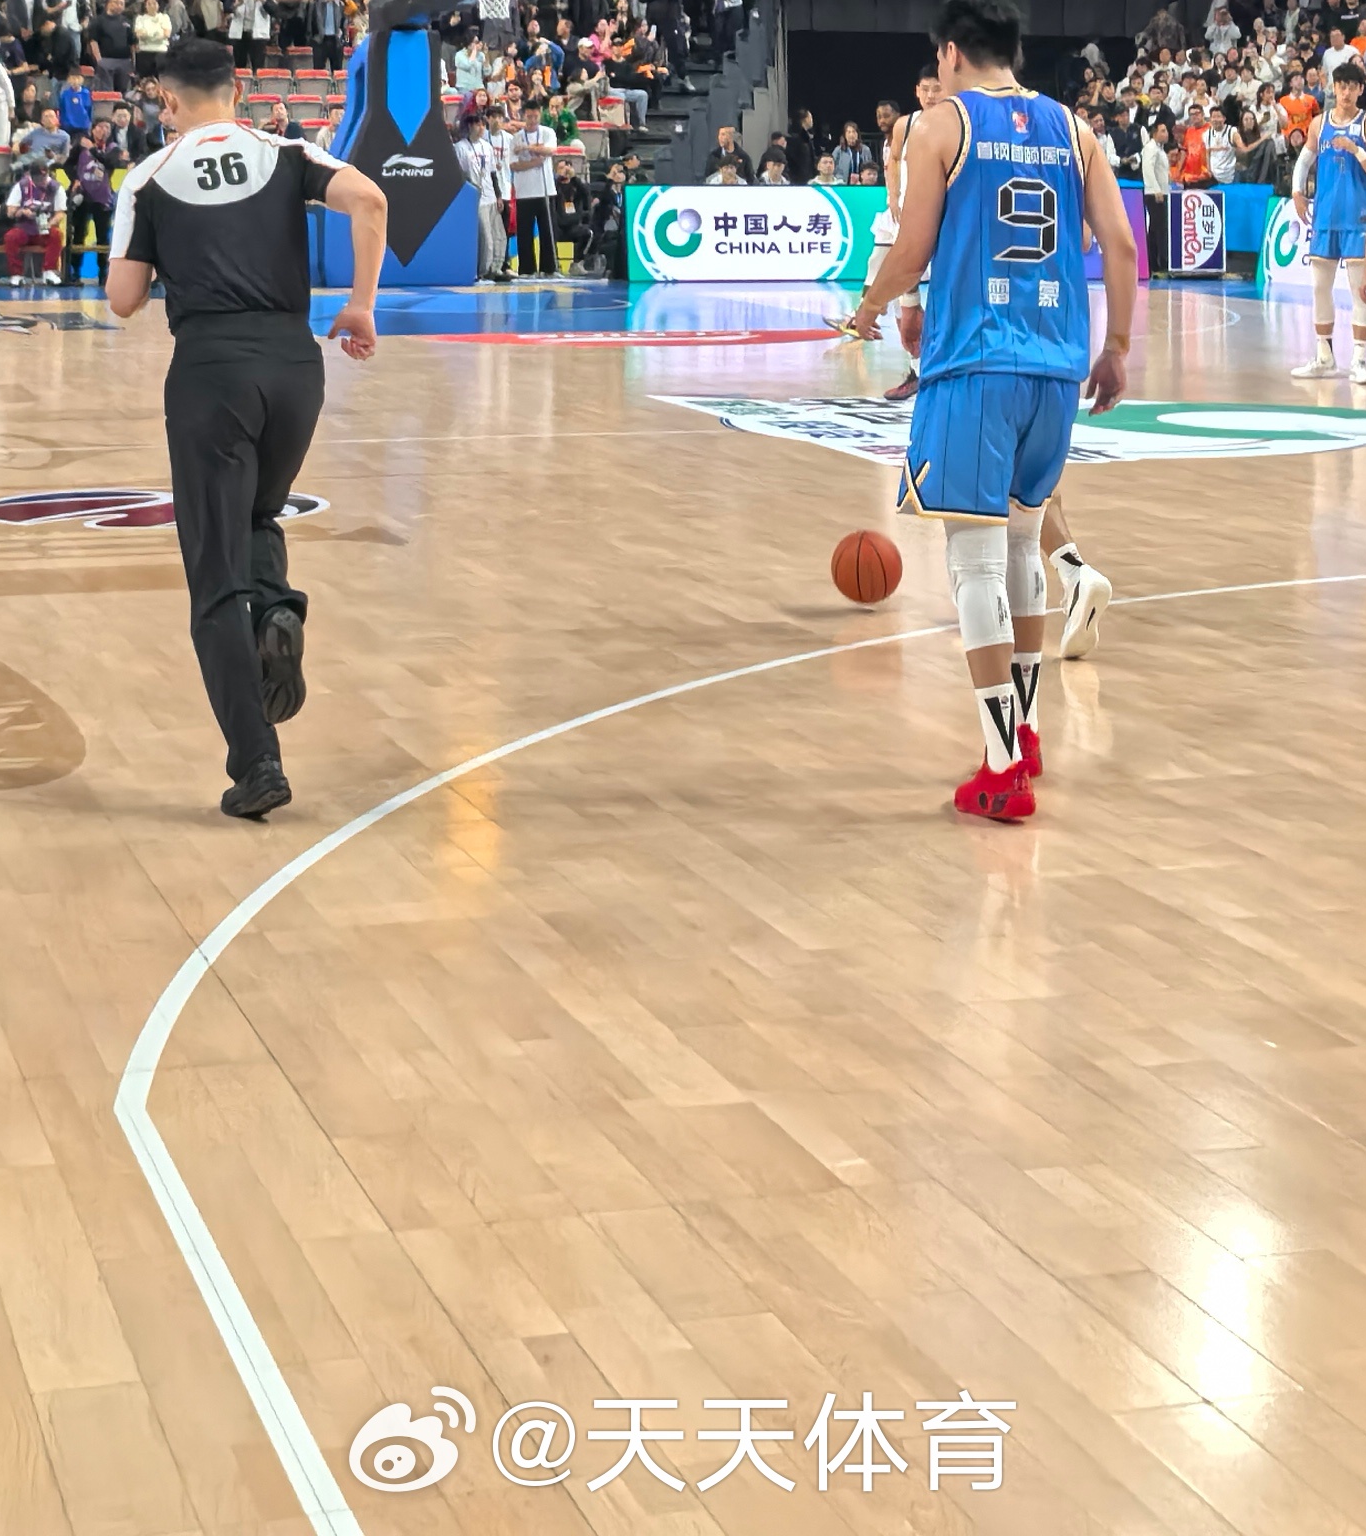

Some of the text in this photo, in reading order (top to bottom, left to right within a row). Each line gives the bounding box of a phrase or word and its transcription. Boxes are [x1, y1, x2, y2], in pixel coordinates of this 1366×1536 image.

[193, 152, 248, 191] 36
[382, 168, 433, 177] LI-NING
[714, 212, 833, 237] 中国人寿
[993, 177, 1058, 263] 9
[1202, 204, 1215, 250] 百岁山
[715, 241, 832, 254] CHINA LIFE
